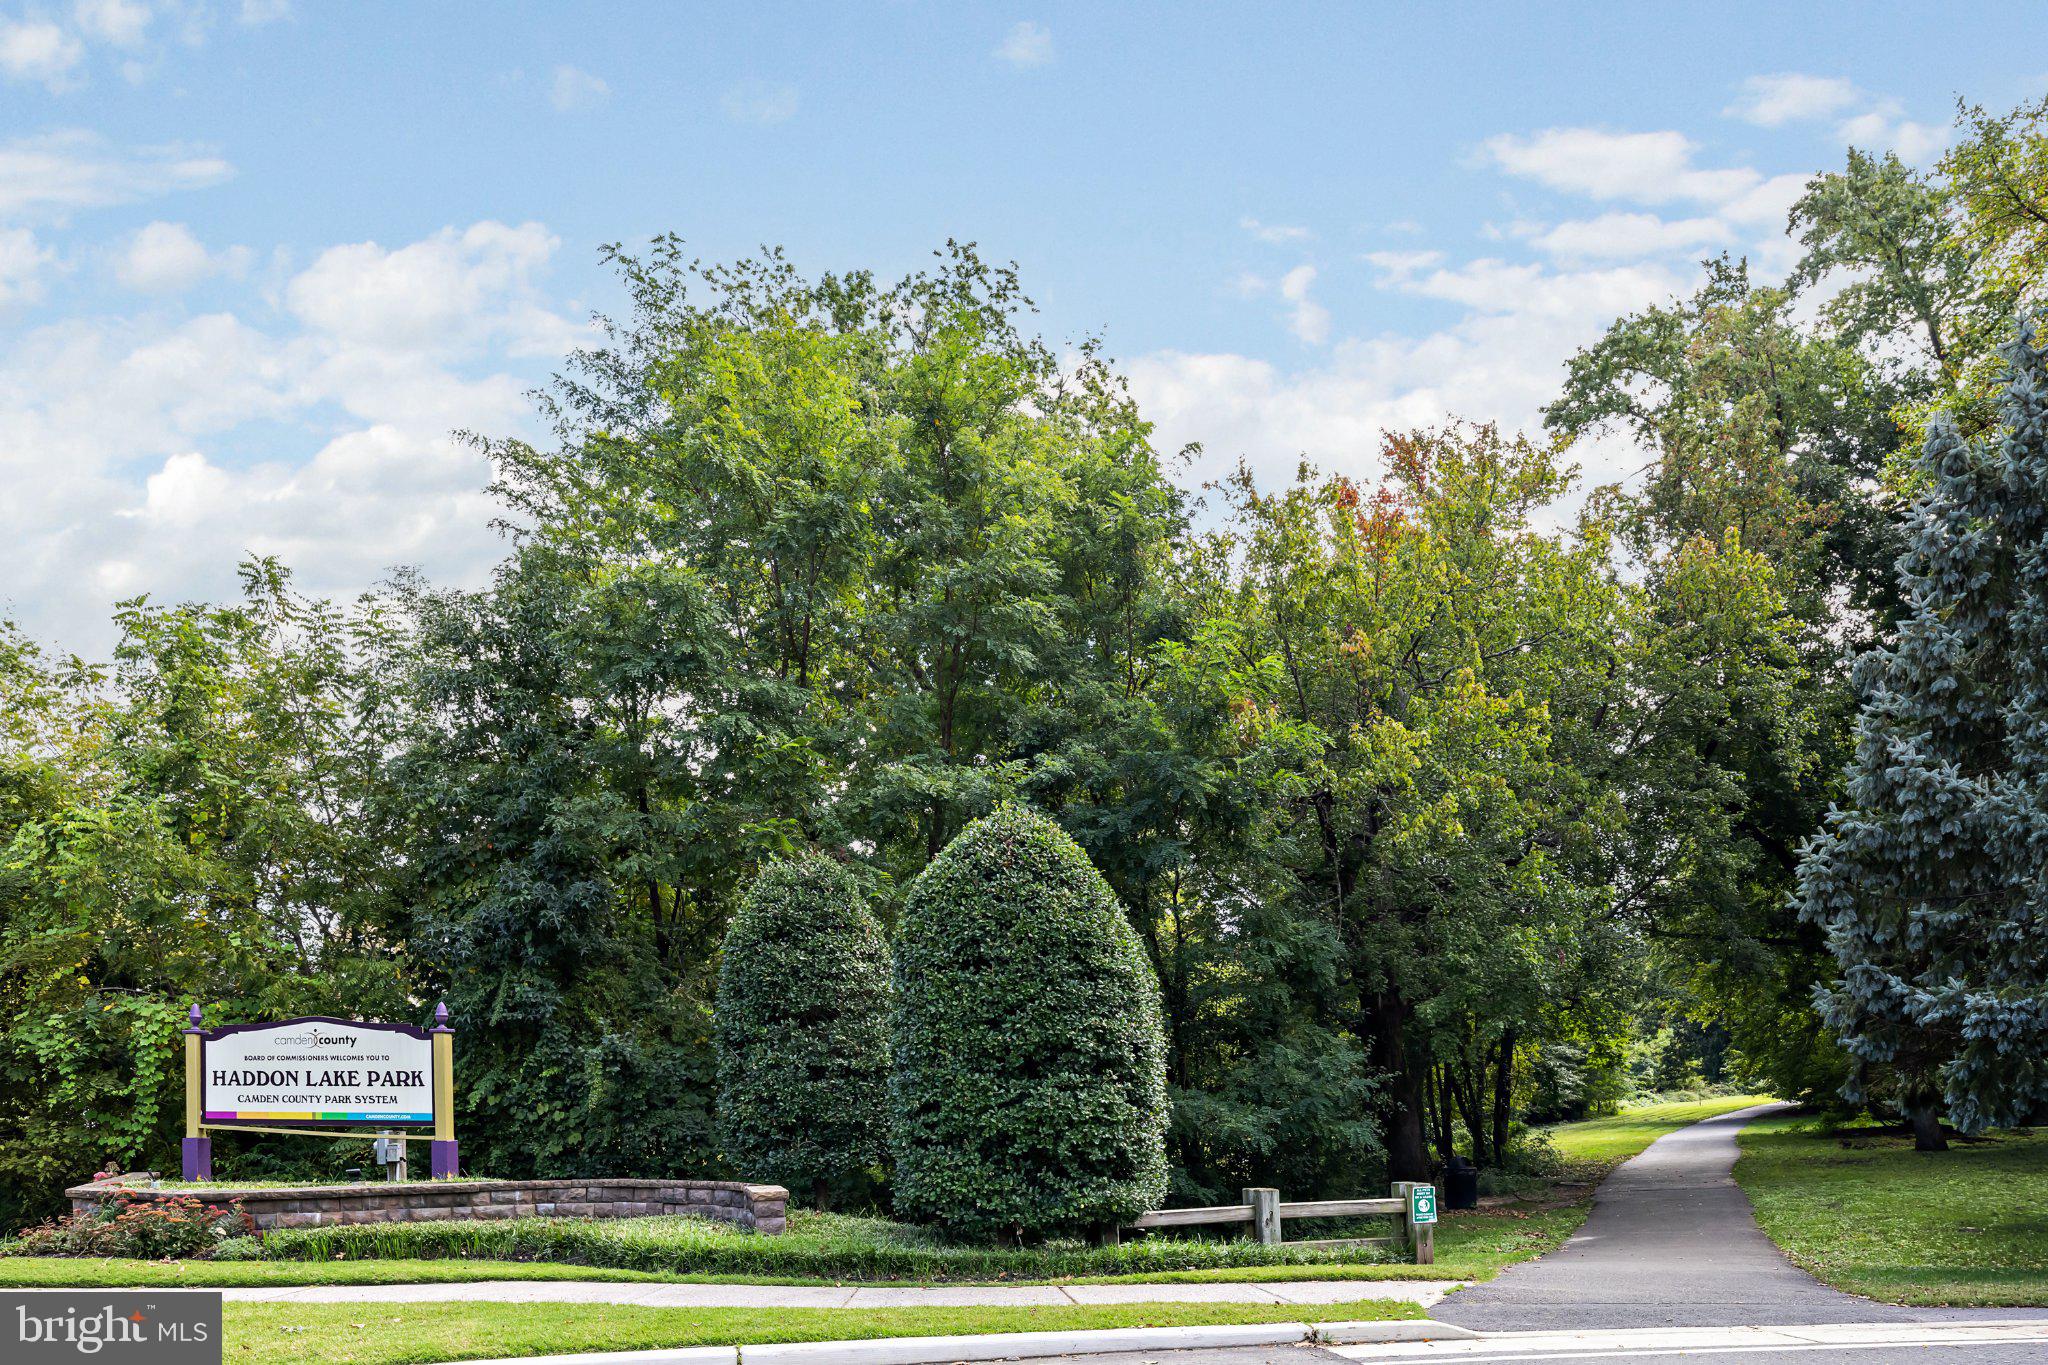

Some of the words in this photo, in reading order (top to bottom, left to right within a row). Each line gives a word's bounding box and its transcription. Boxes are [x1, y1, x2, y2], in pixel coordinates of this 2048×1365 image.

[318, 1035, 358, 1048] county
[212, 1070, 299, 1087] HADDON
[305, 1070, 361, 1087] LAKE
[366, 1070, 425, 1087] PARK
[237, 1094, 279, 1104] CAMDEN
[281, 1094, 322, 1104] COUNTY
[324, 1095, 352, 1104] PARK
[354, 1095, 398, 1105] SYSTEM
